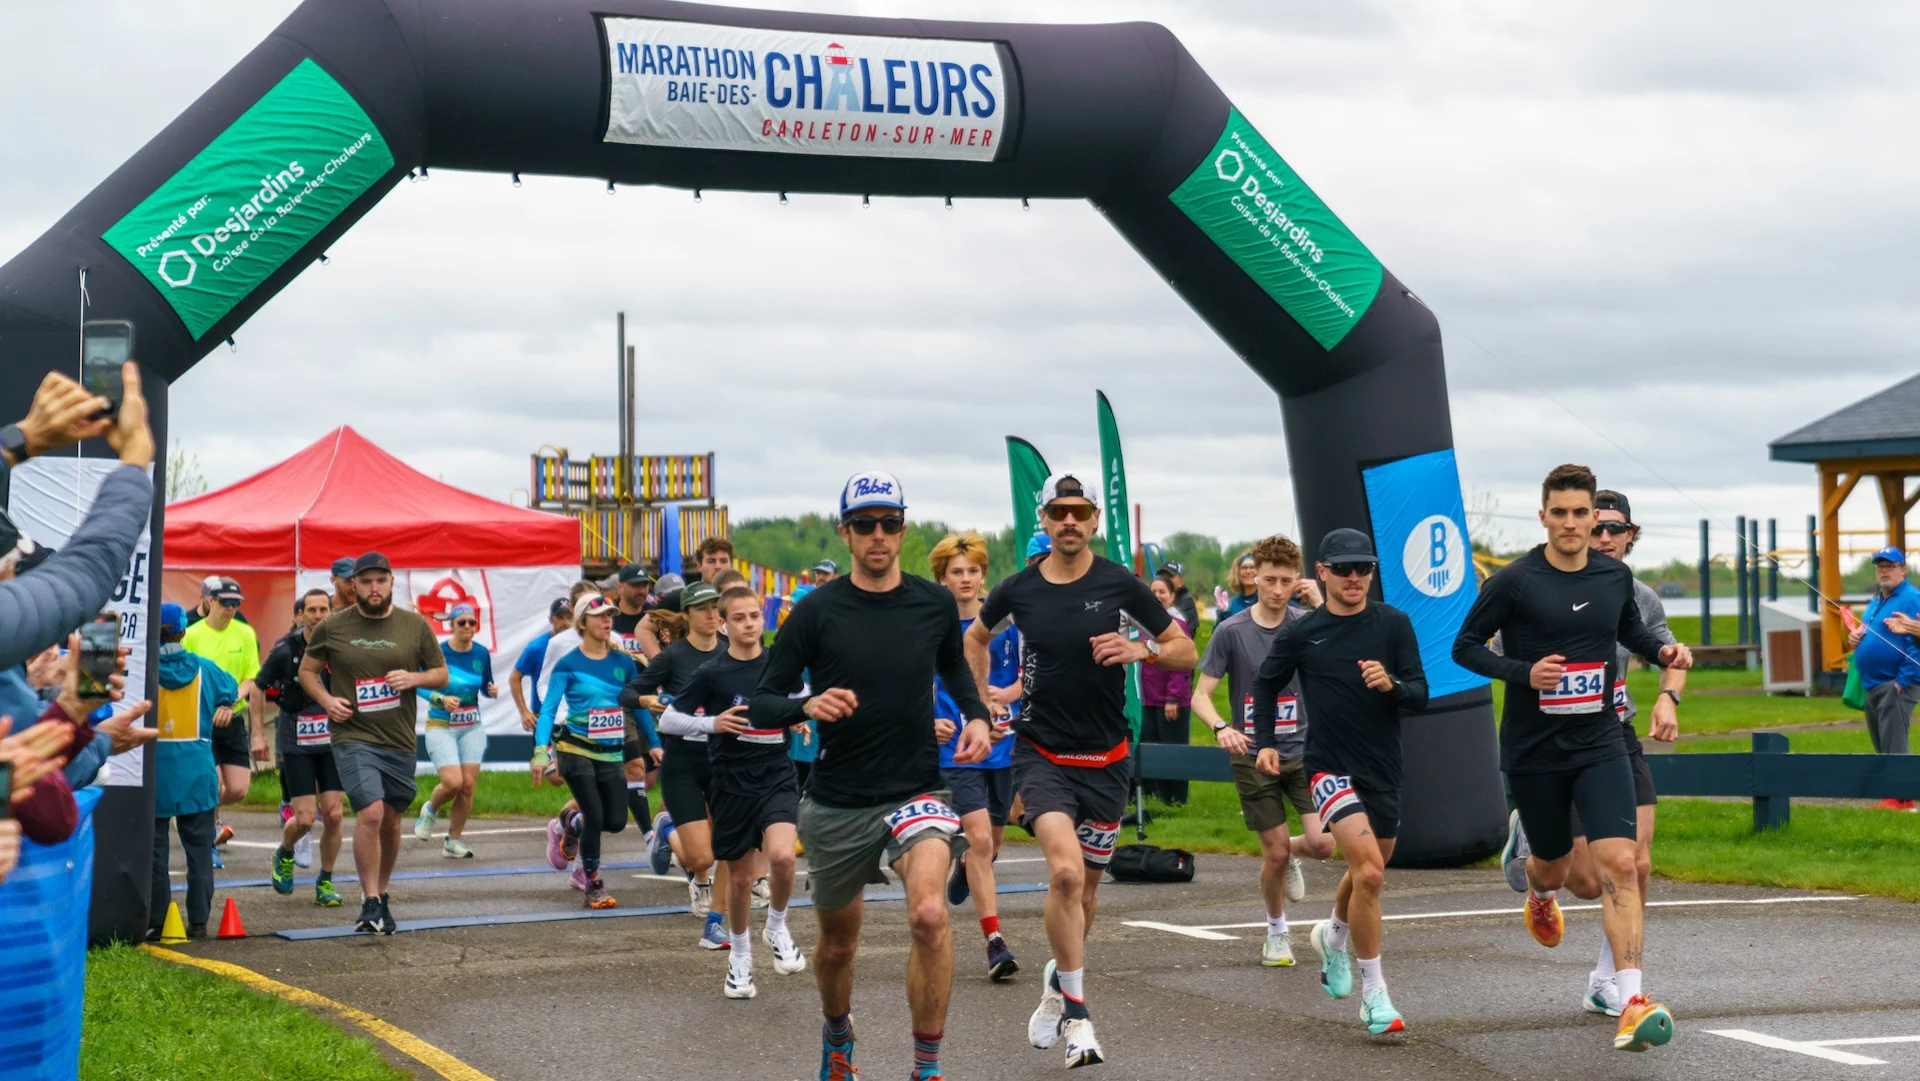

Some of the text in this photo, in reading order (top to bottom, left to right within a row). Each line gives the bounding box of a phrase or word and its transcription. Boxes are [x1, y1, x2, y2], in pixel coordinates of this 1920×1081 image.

[616, 43, 757, 80] MARATHON
[765, 48, 997, 118] CHALEURS
[667, 81, 757, 106] BAIE-DES-
[761, 119, 993, 147] CARLETON-SUR-MER
[1231, 131, 1284, 188] Présenté par:
[136, 194, 212, 258] Présenté par:
[191, 161, 305, 257] Desjardins
[212, 132, 372, 272] Caisse de la Baie-des-Chaleurs
[1241, 175, 1324, 263] Desjardins
[1231, 195, 1355, 318] Caisse de la Baie-des-Chaleurs
[853, 477, 892, 498] Pabst
[1430, 521, 1447, 569] B
[591, 715, 622, 727] 2206
[1056, 754, 1107, 762] SALOMON
[1079, 827, 1118, 849] 212
